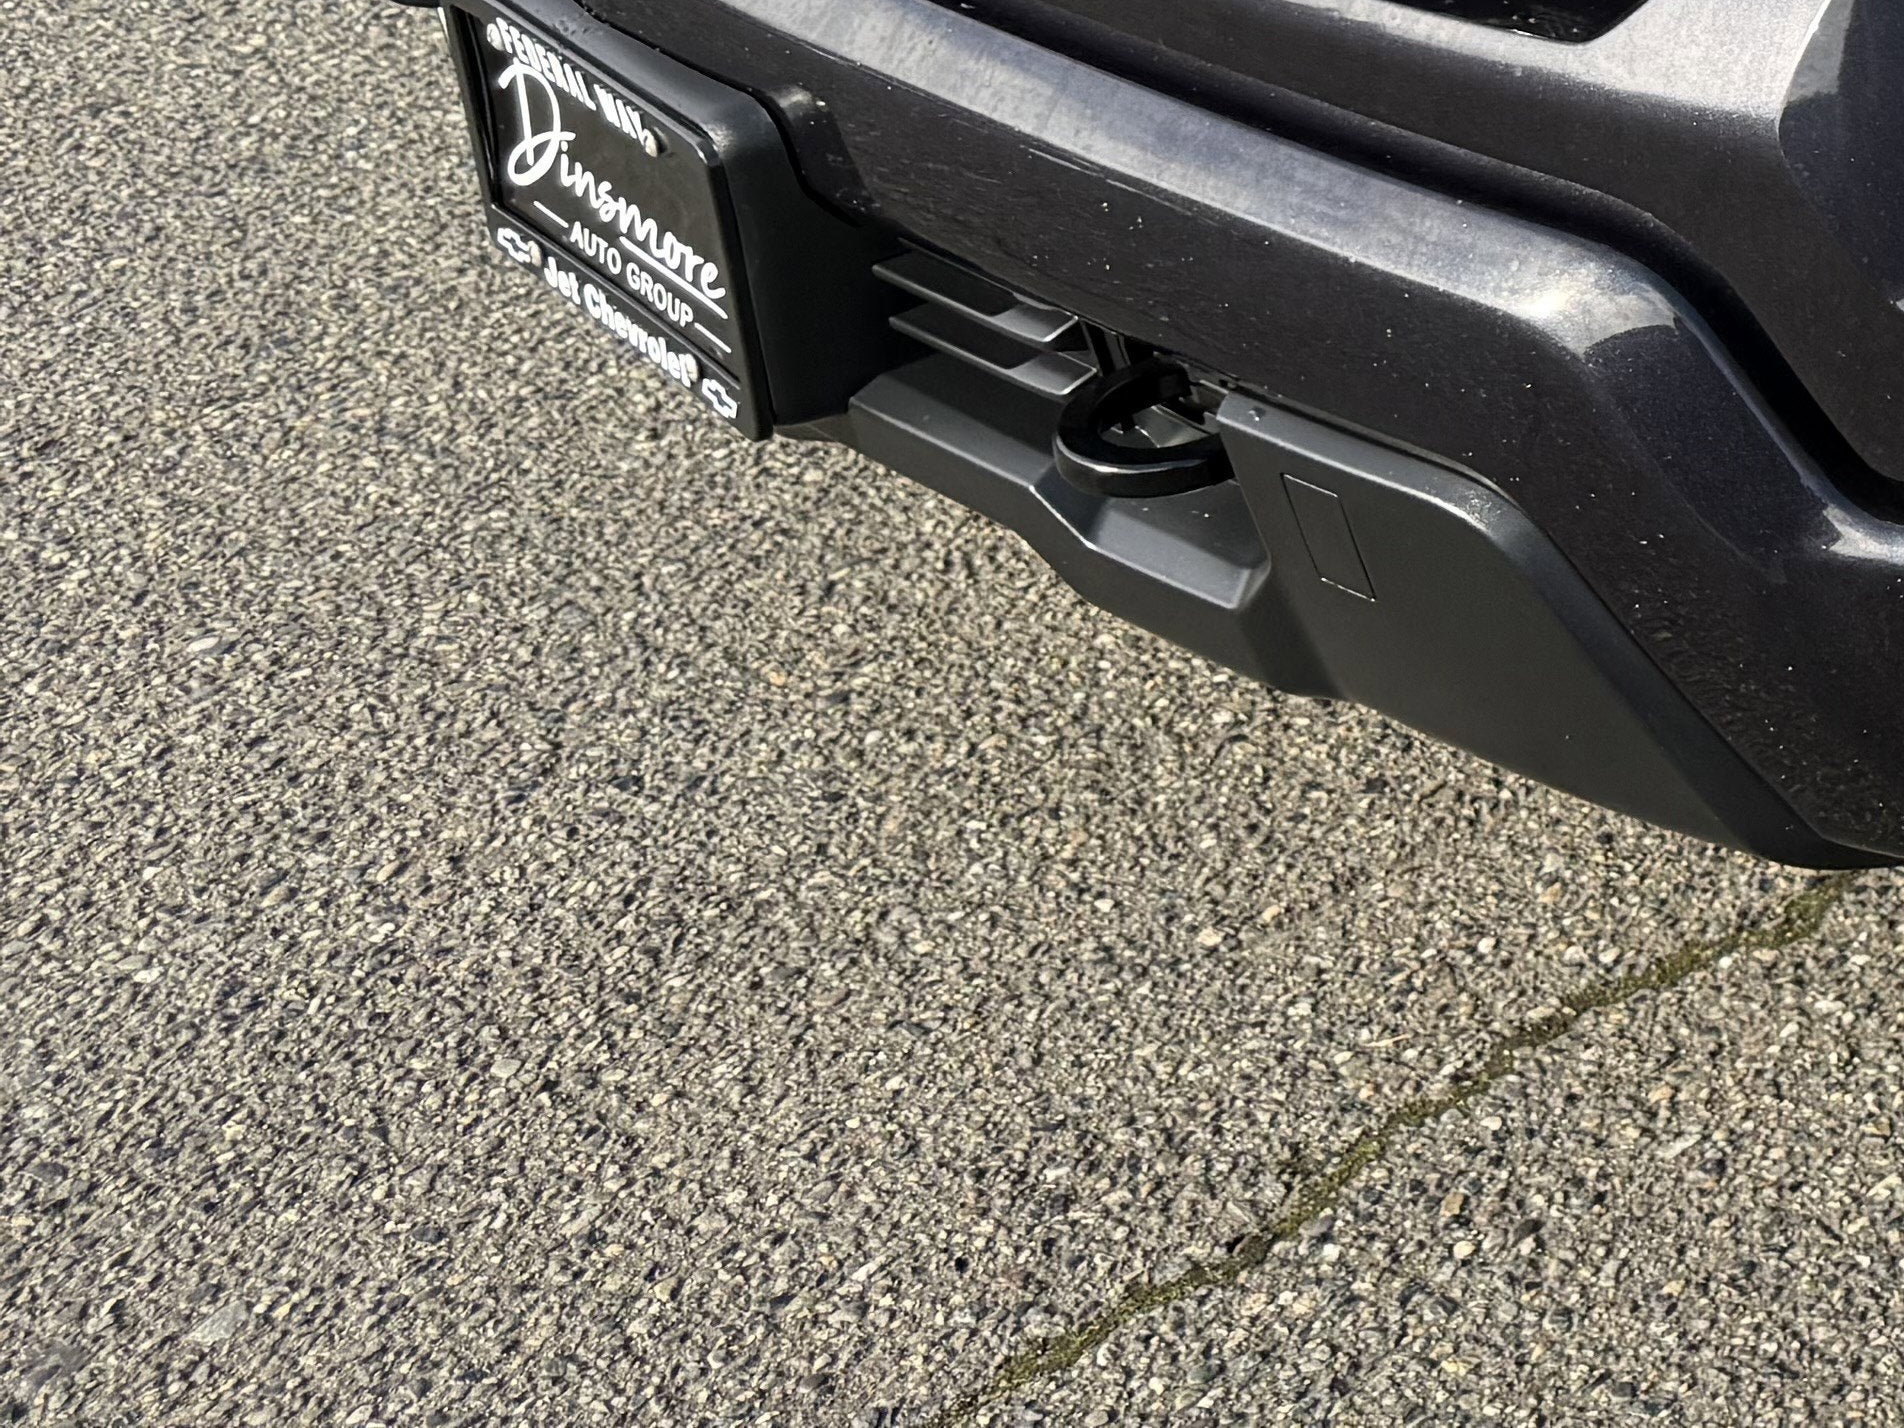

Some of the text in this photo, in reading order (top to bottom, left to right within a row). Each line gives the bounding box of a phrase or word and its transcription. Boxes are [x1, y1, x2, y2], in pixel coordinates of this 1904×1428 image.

[496, 17, 597, 111] FEDERAL
[498, 57, 726, 299] Dinsmore
[544, 256, 695, 388] Jet Chevrolet
[570, 221, 694, 327] AUTO GROUP
